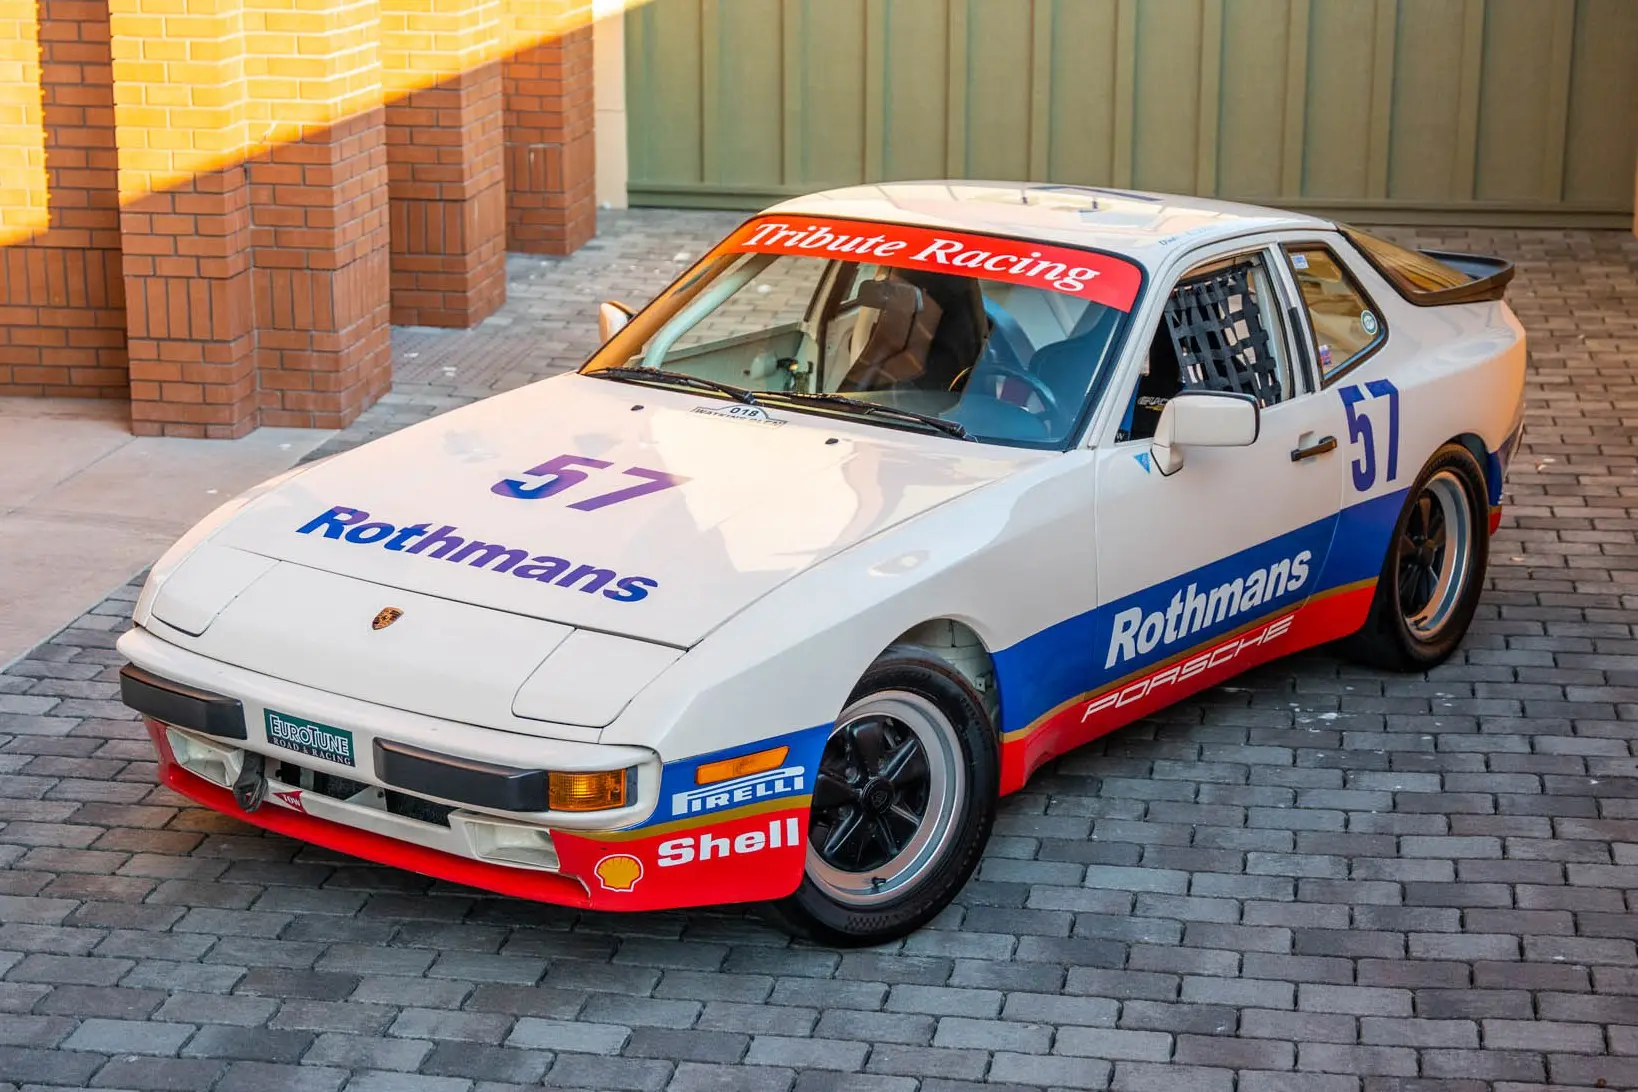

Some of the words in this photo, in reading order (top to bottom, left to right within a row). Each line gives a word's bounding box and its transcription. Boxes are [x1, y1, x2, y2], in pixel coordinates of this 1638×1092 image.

[741, 222, 908, 258] Tribute
[912, 238, 1101, 293] Racing
[729, 407, 759, 418] 018
[1338, 378, 1399, 492] 57
[490, 454, 692, 512] 57
[295, 505, 659, 603] Rothmans
[1103, 549, 1312, 670] Rothmans
[1081, 614, 1295, 723] PORSCHE
[272, 737, 300, 752] ROAD
[312, 749, 351, 767] RACING
[671, 766, 805, 816] PIRELLI
[657, 817, 800, 867] Shell
